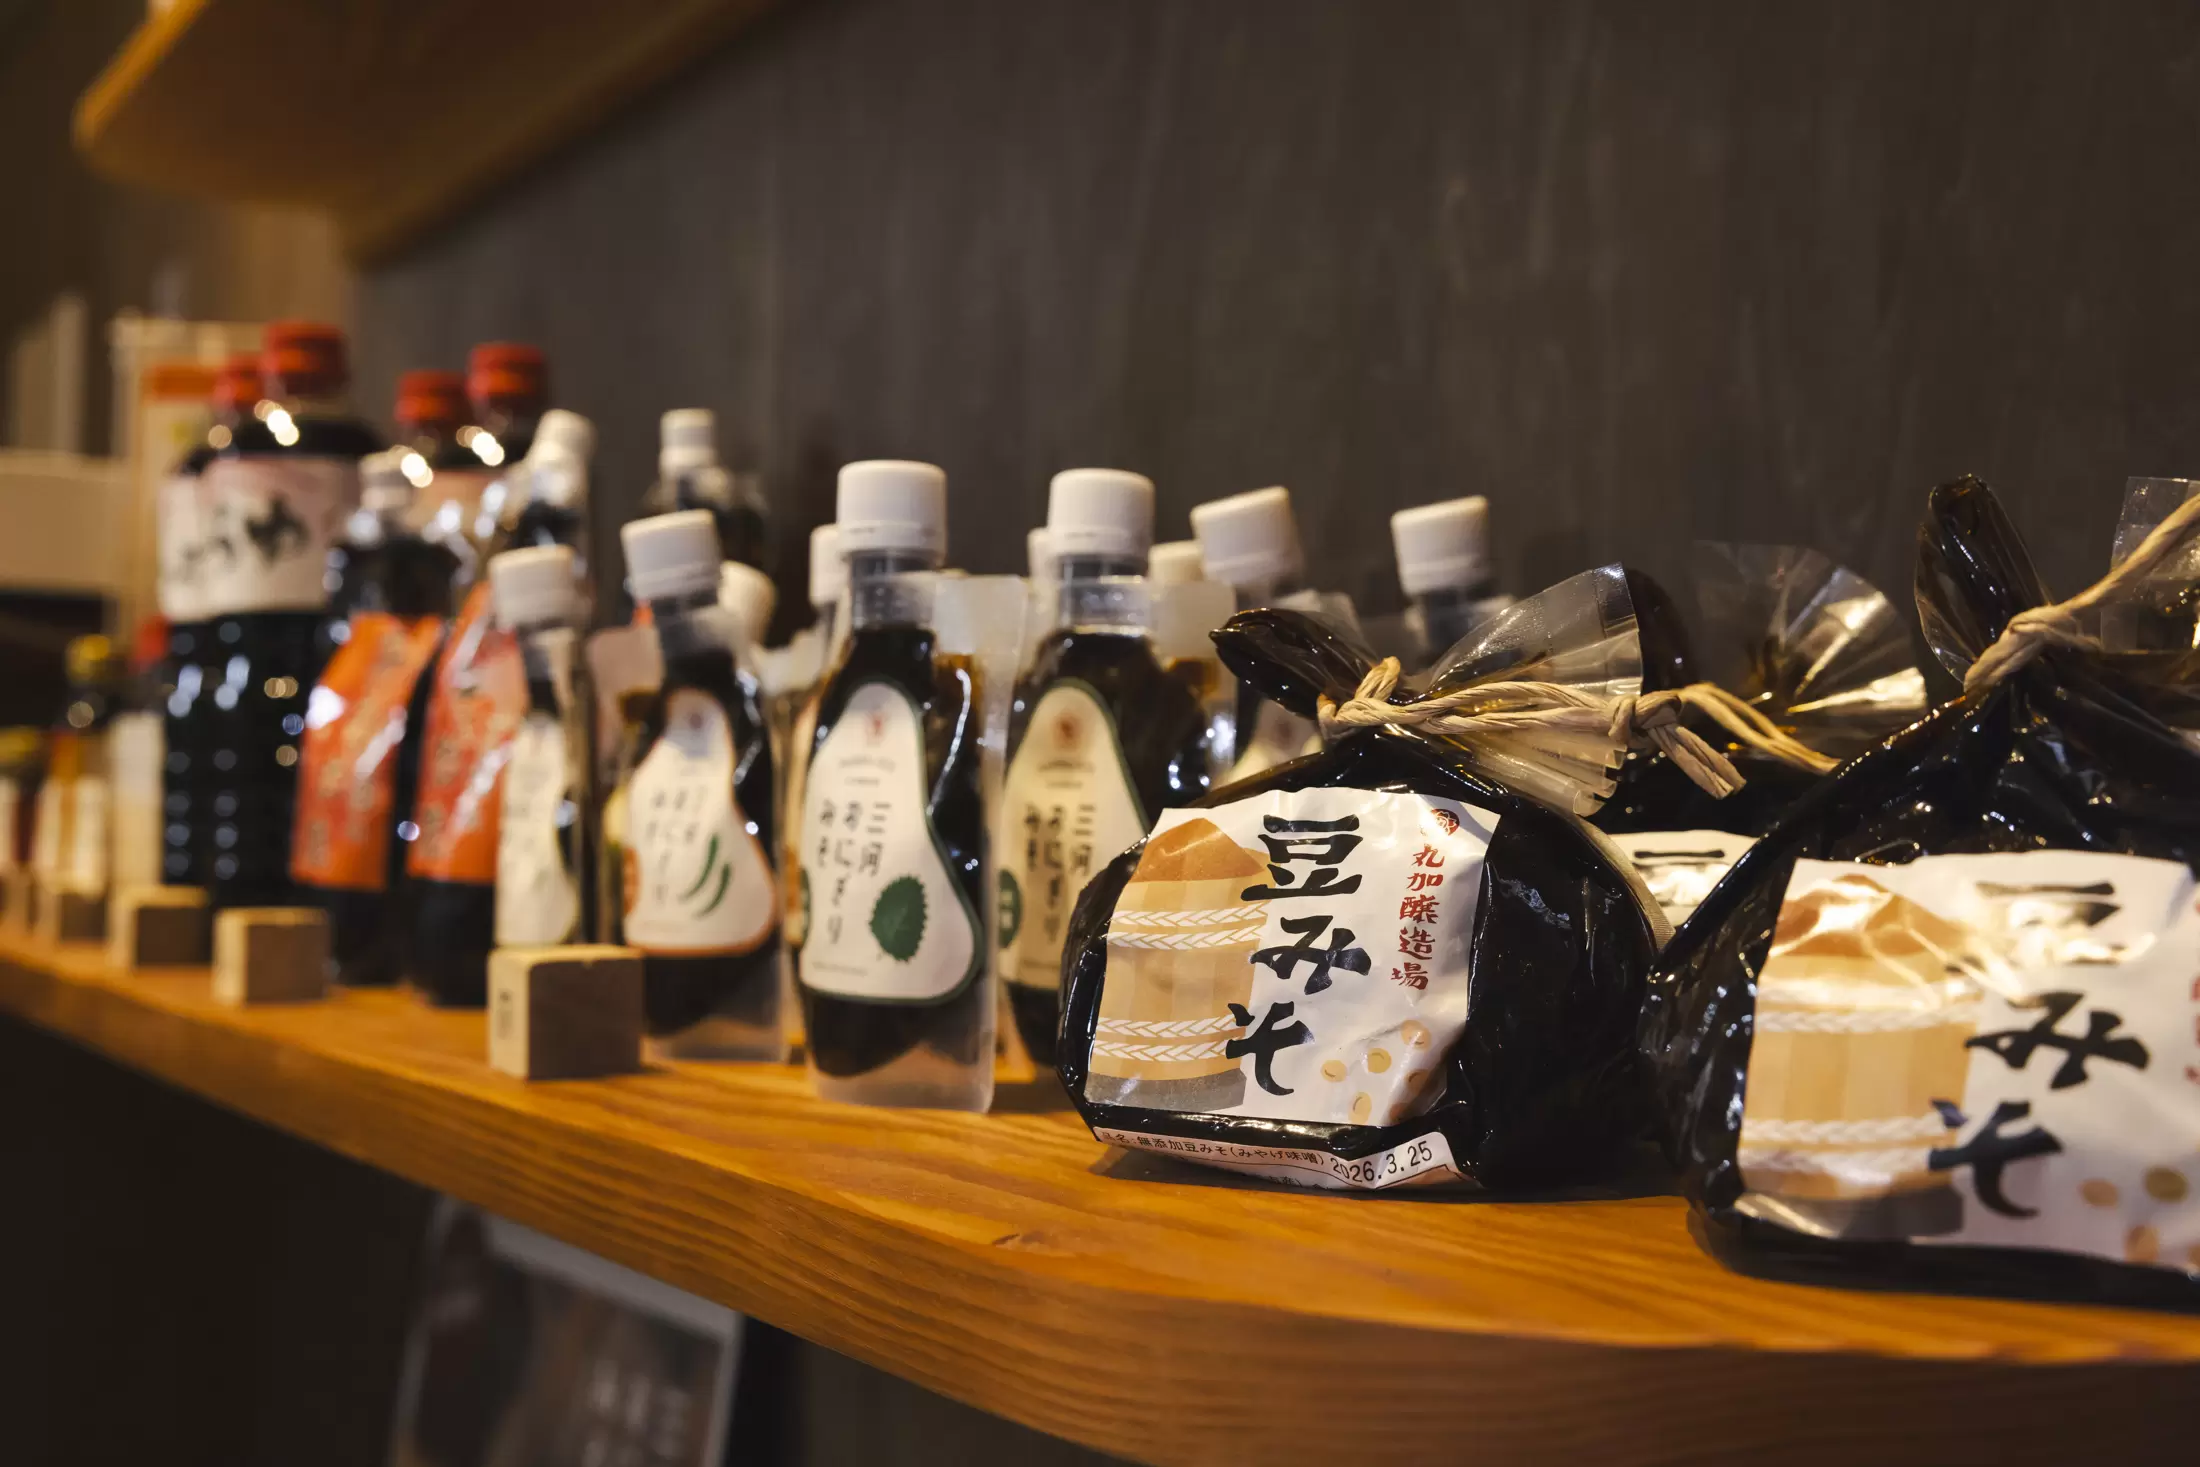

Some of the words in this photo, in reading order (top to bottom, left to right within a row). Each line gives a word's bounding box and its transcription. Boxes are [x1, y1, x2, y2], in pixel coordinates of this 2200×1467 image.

[1225, 815, 1372, 1095] 豆みそ
[1391, 844, 1445, 990] 丸加醸造場
[1330, 1140, 1433, 1183] 2026.3.25
